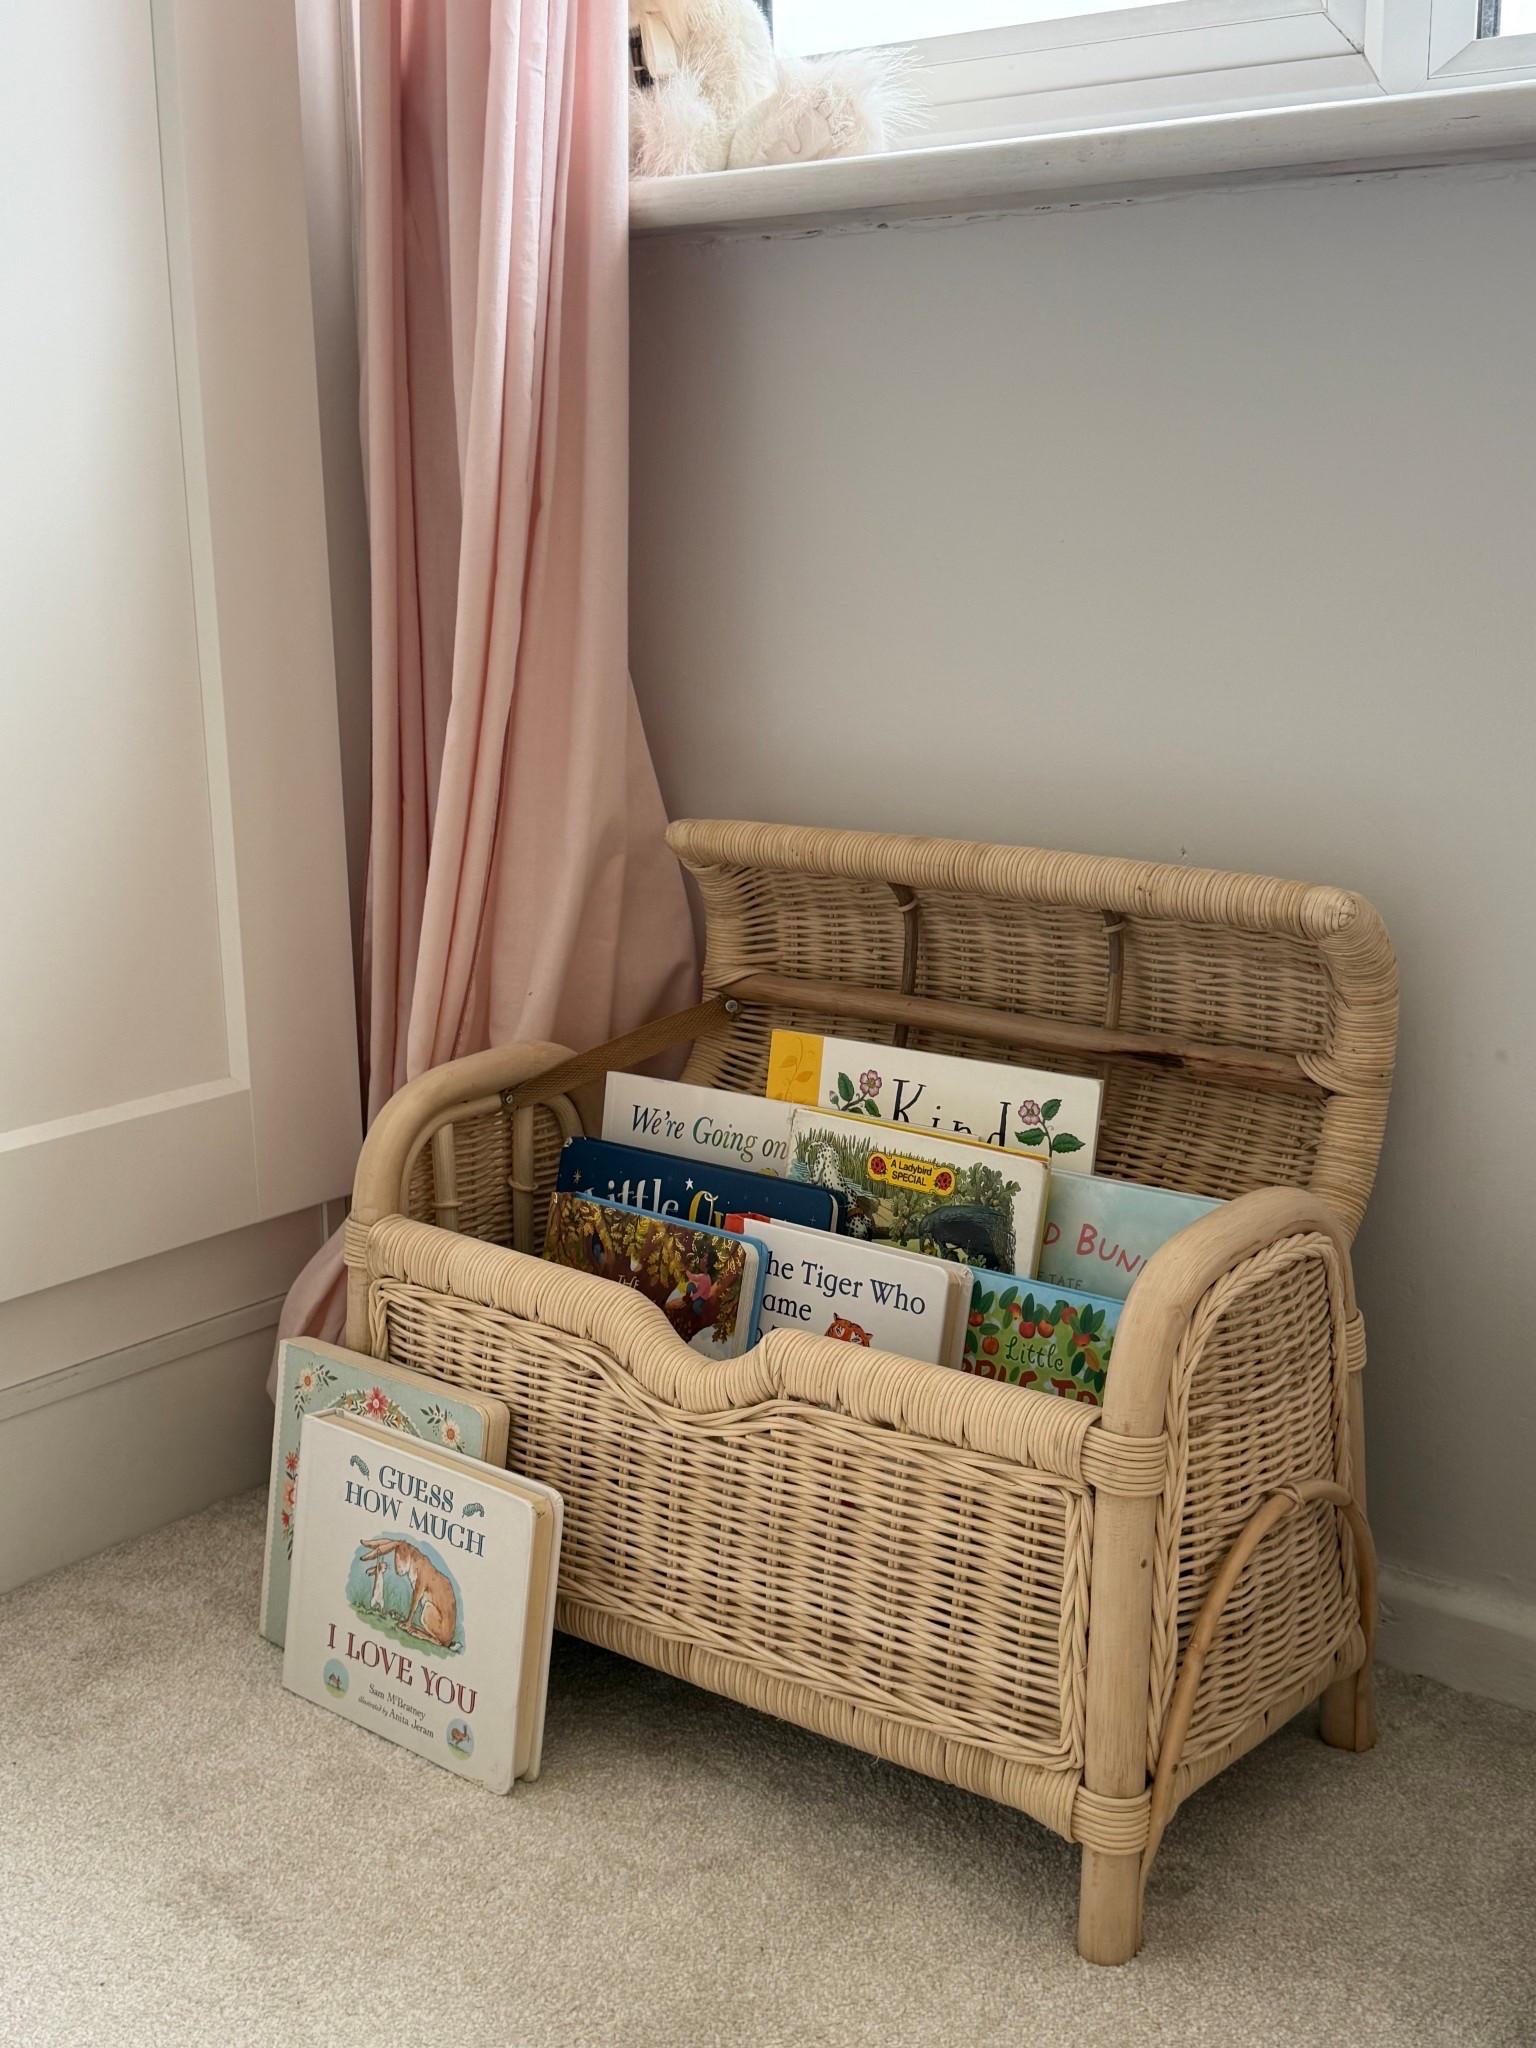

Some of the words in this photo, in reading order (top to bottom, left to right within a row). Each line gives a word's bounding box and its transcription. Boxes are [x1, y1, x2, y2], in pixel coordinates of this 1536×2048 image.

[632, 1104, 685, 1140] We're
[692, 1116, 758, 1163] Going
[762, 1138, 788, 1160] on
[890, 1159, 897, 1168] A
[898, 1160, 933, 1176] Ladybird
[891, 1170, 927, 1186] SPECIAL
[765, 1250, 794, 1280] he
[801, 1260, 863, 1298] Tiger
[870, 1278, 926, 1315] Who
[762, 1293, 812, 1321] ame
[1005, 1336, 1064, 1372] Little
[378, 1465, 454, 1513] GUESS
[344, 1480, 403, 1521] HOW
[409, 1506, 486, 1557] MUCH
[327, 1622, 337, 1649] I
[345, 1631, 413, 1686] LOVE
[421, 1665, 478, 1714] YOU
[368, 1683, 385, 1700] Sam
[389, 1708, 409, 1726] Anita
[410, 1719, 434, 1738] Jeram
